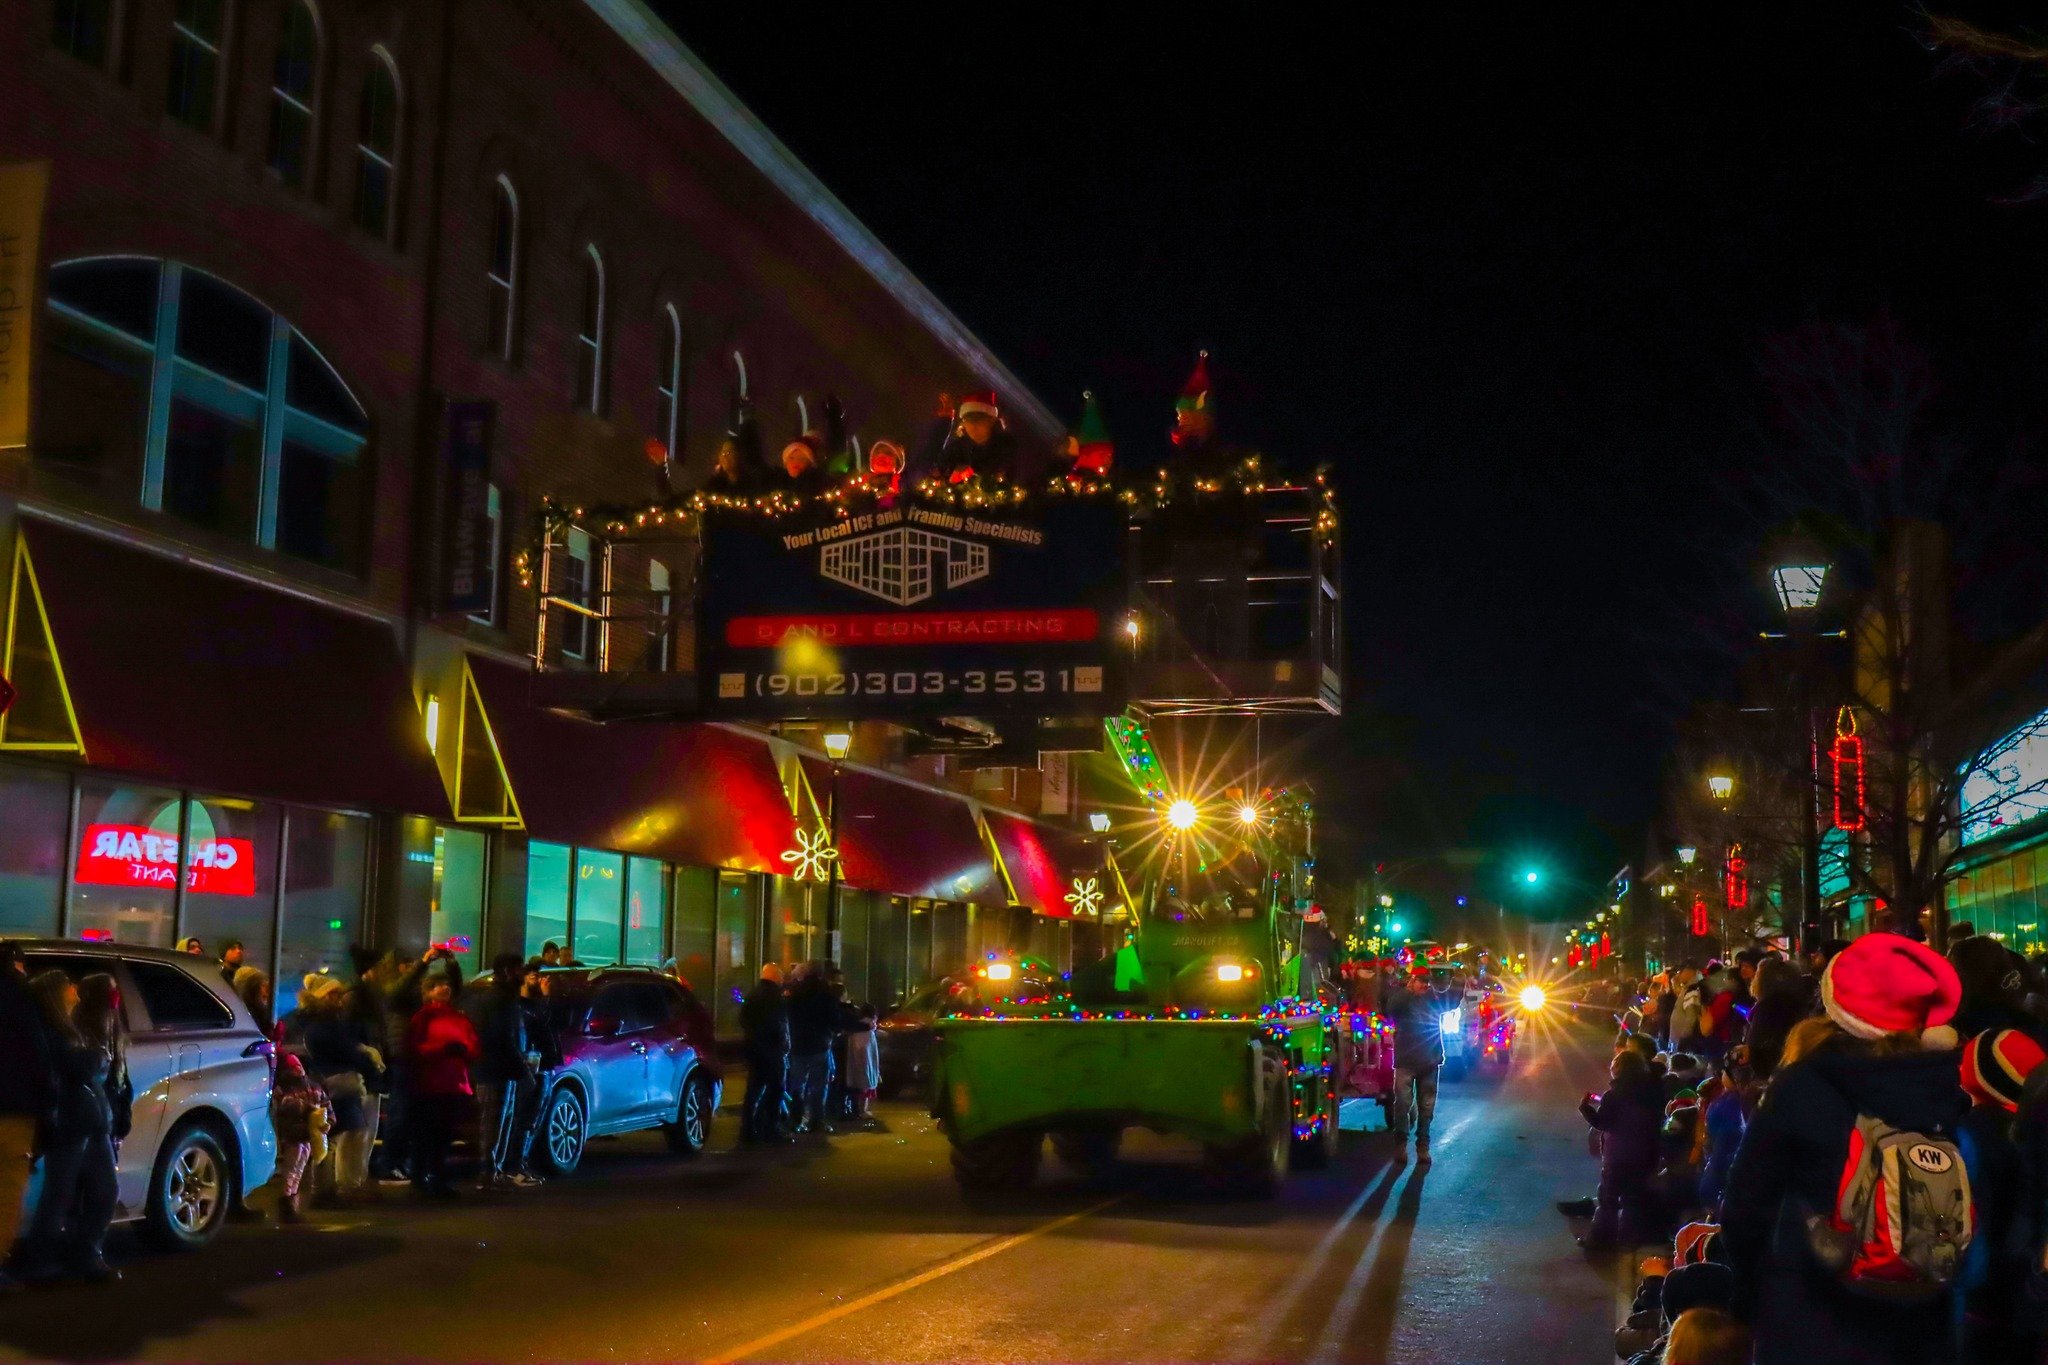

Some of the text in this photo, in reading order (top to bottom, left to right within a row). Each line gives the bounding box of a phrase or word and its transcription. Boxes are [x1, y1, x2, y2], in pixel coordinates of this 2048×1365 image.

[783, 505, 1042, 550] Your Local ICF and Framing Specialists
[783, 623, 837, 638] AND
[851, 623, 863, 636] L
[874, 617, 1063, 637] CONTRACTING
[755, 669, 1069, 697] (902)303-3531
[1917, 1148, 1942, 1166] KW
